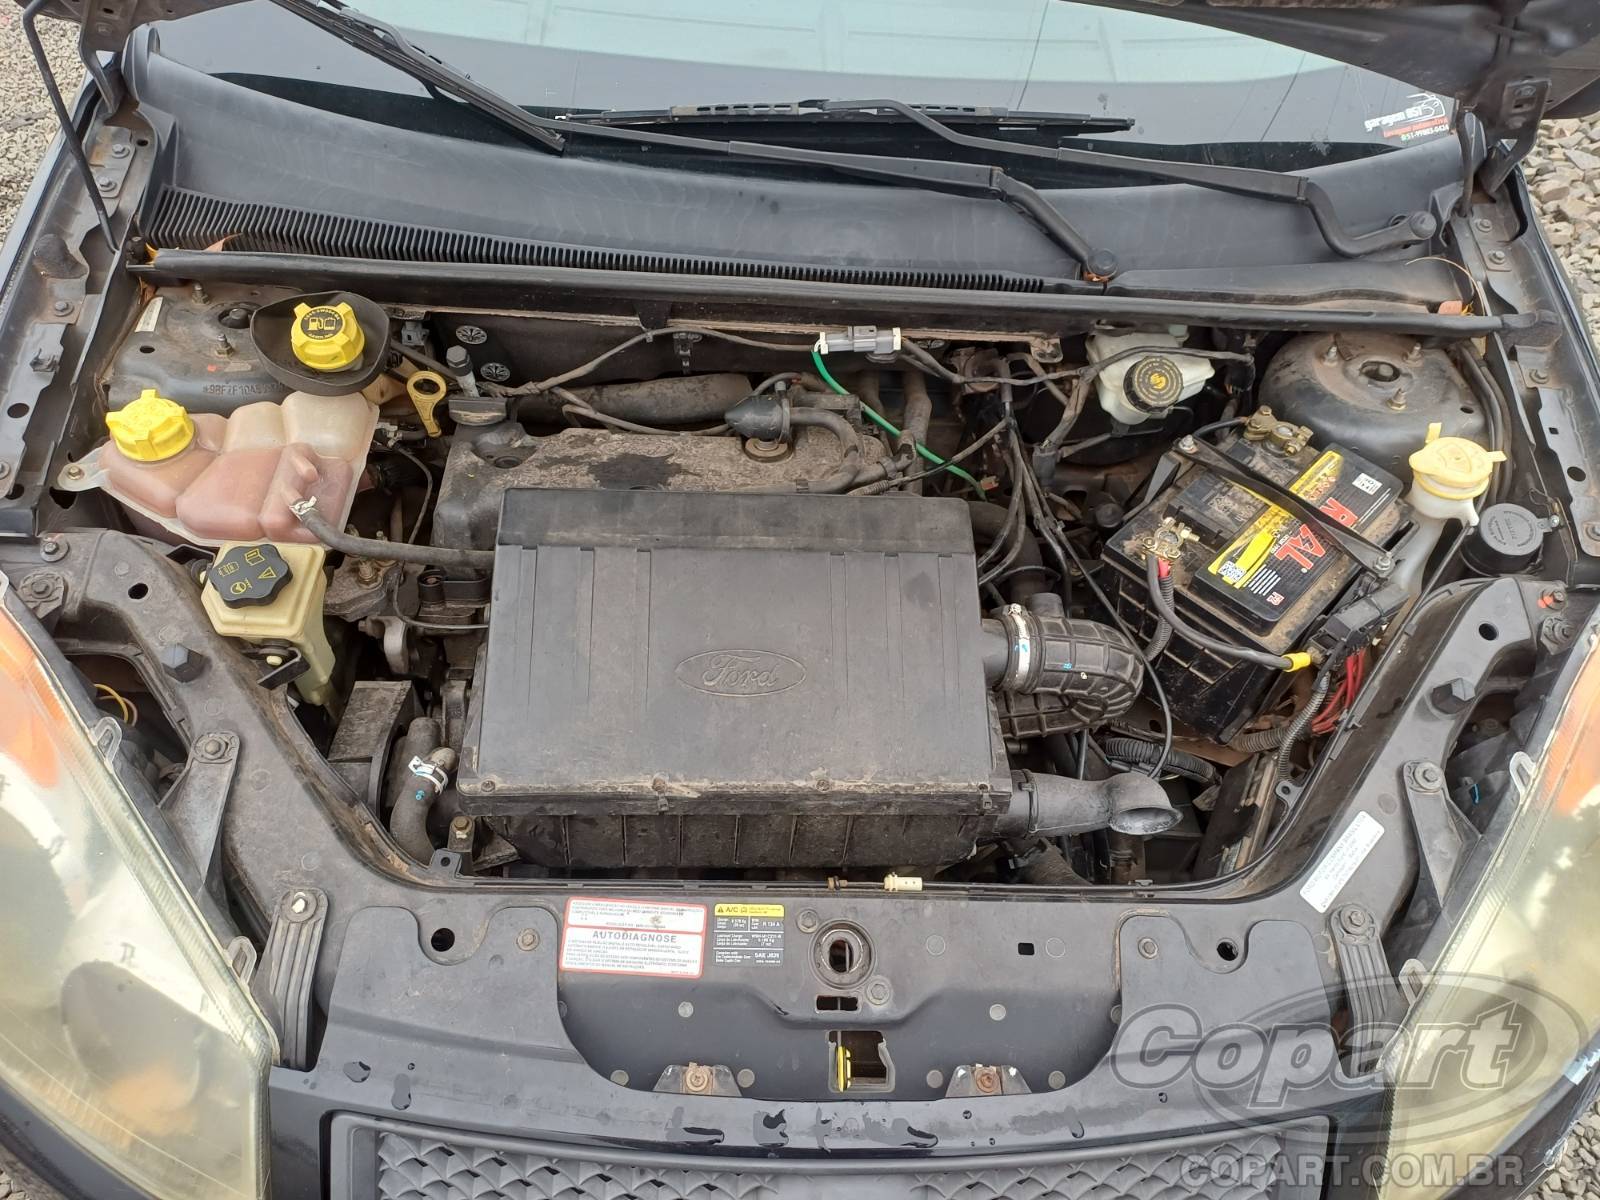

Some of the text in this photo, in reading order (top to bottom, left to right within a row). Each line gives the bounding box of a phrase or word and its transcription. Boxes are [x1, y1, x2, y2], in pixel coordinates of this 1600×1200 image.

[1275, 496, 1358, 569] RAL
[702, 654, 785, 688] Ford
[592, 930, 677, 944] AUTODIAGNOSE
